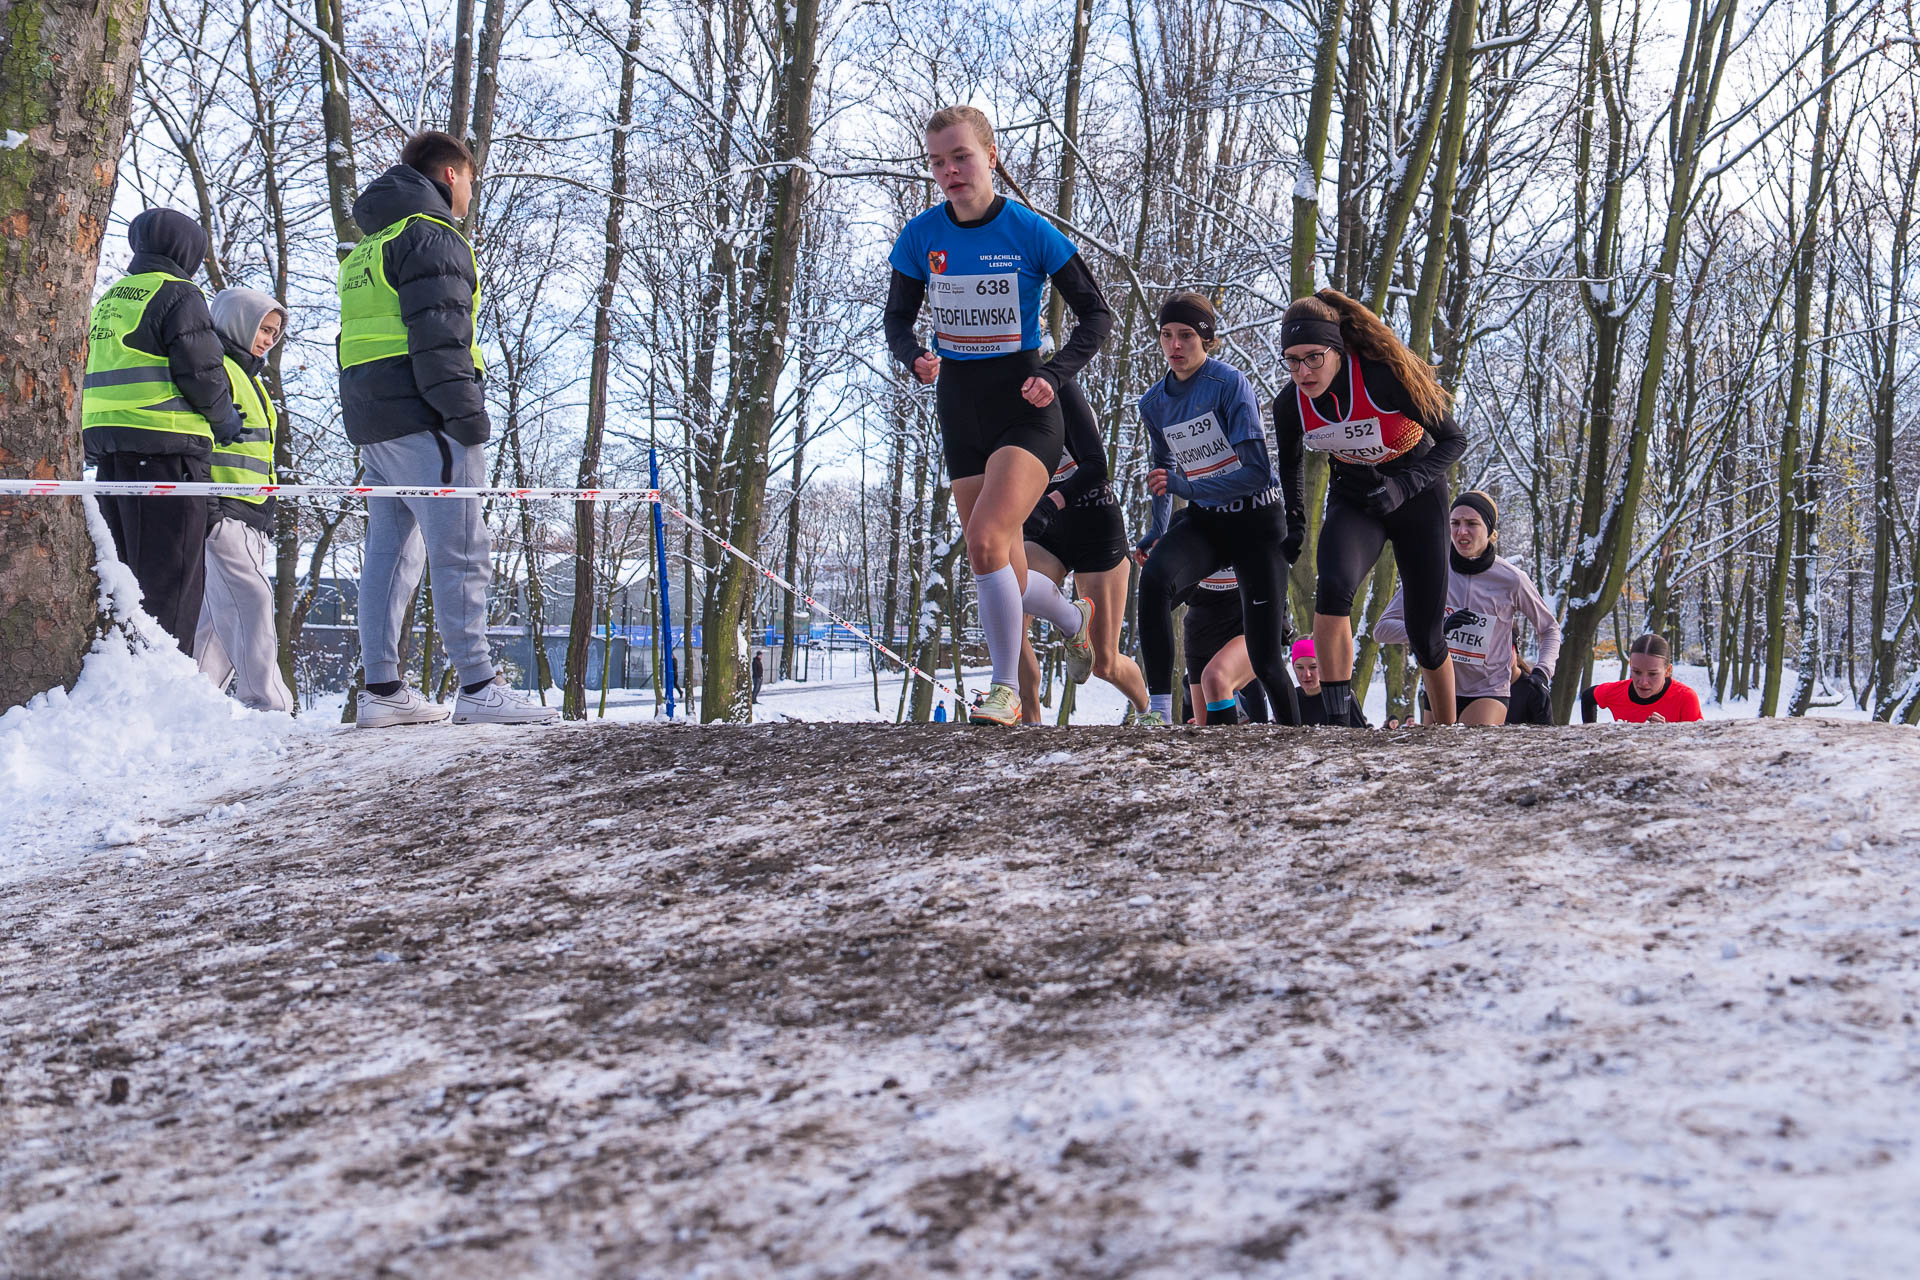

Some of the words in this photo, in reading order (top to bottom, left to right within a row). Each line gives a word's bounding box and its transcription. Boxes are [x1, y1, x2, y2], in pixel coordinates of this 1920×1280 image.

[975, 279, 1010, 296] 638
[933, 306, 1017, 327] TEOFILEWSKA
[952, 344, 979, 352] BYTOM
[980, 344, 1001, 352] 2024
[1188, 418, 1212, 437] 239
[1344, 423, 1374, 440] 552
[1175, 437, 1229, 465] SUCHOWOLAK
[1471, 615, 1488, 628] 93
